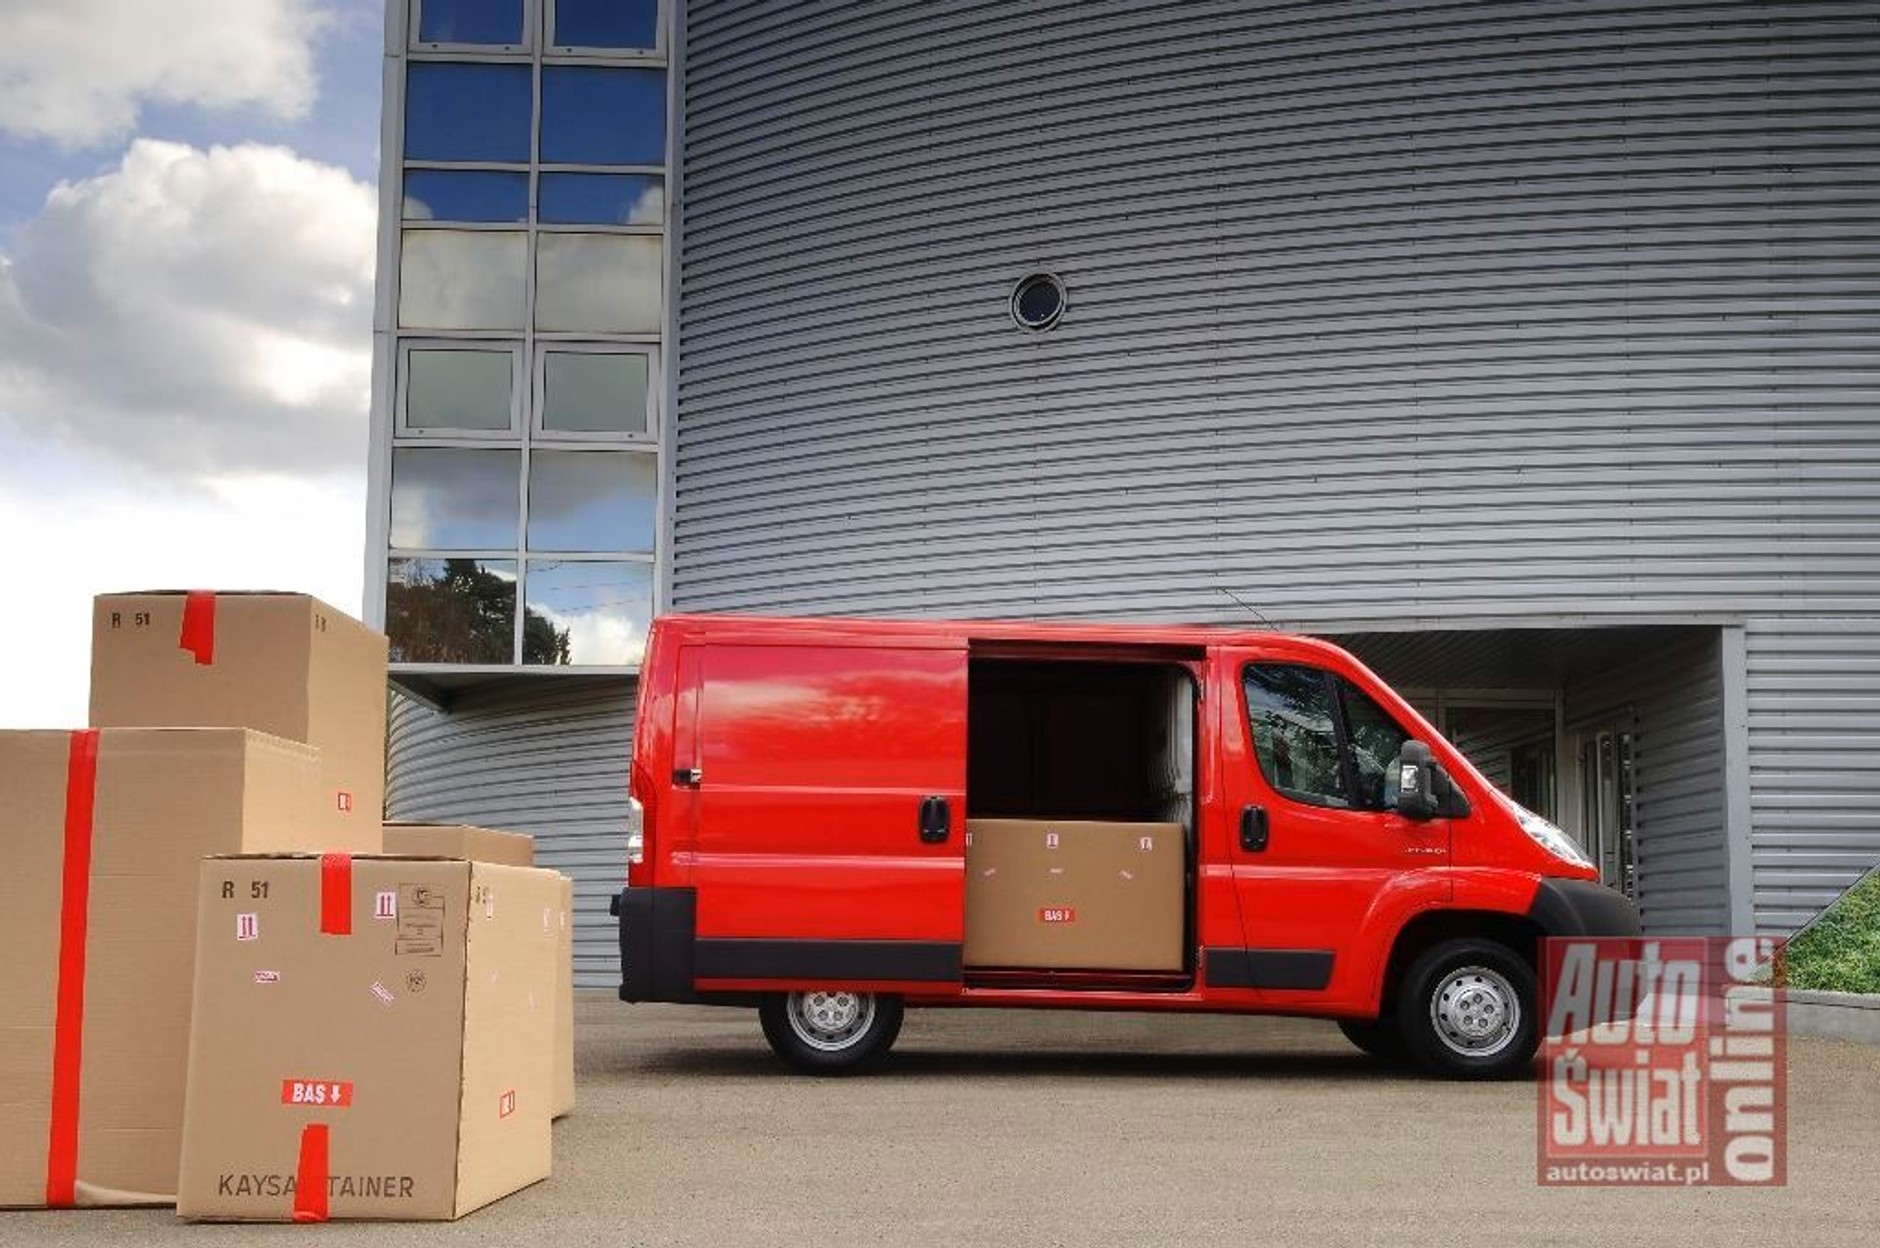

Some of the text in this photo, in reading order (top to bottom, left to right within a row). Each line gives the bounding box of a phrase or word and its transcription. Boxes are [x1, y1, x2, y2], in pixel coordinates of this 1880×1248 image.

[111, 612, 151, 629] R 51
[221, 880, 270, 899] R 51
[1044, 910, 1063, 922] BAS
[291, 1081, 326, 1104] BAS
